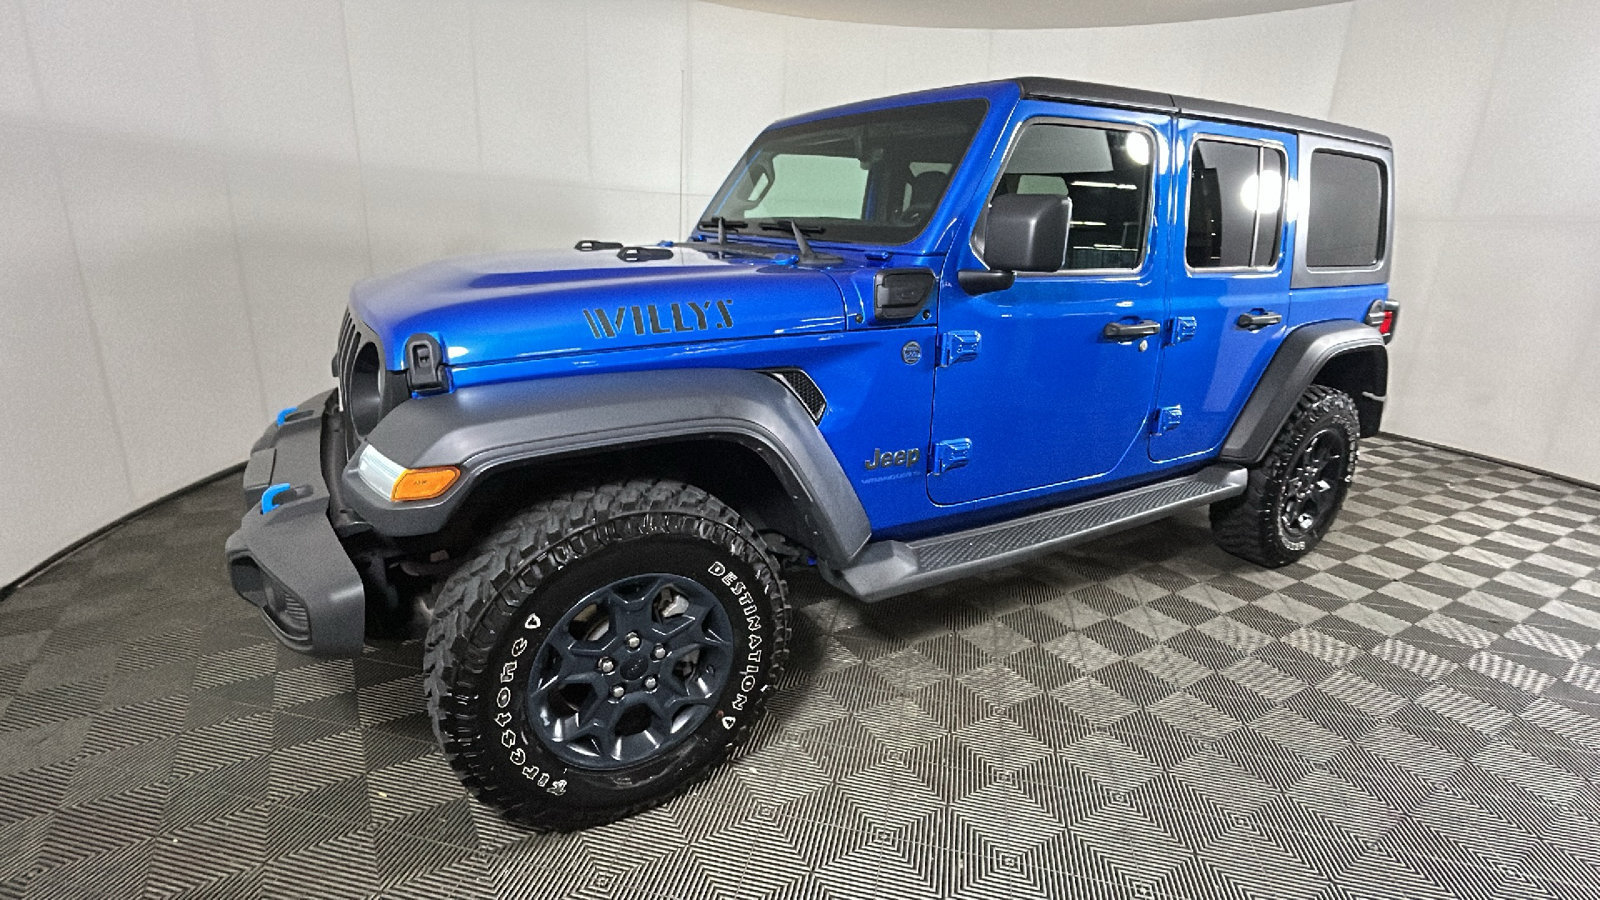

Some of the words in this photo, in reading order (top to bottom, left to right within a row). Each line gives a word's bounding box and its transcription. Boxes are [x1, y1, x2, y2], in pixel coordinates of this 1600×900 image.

[583, 299, 733, 339] WILLYS
[865, 448, 920, 470] Jeep
[708, 561, 762, 710] DESTINATION
